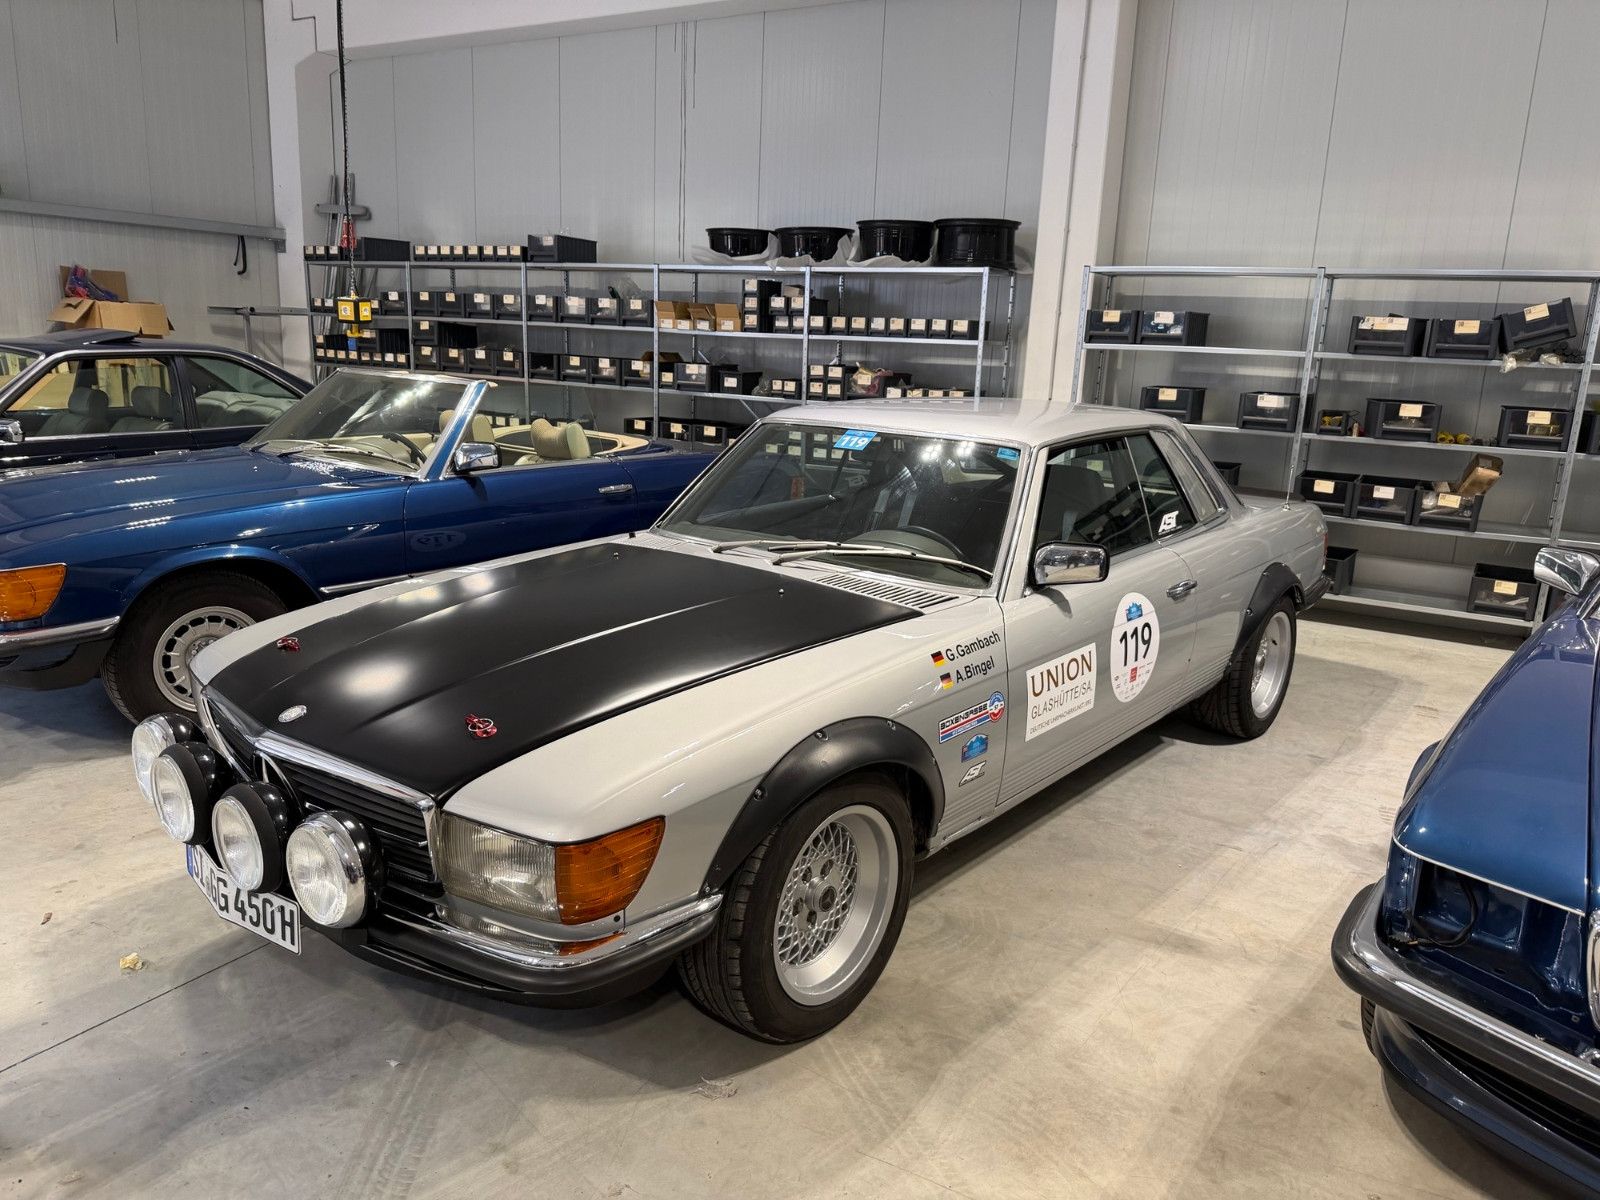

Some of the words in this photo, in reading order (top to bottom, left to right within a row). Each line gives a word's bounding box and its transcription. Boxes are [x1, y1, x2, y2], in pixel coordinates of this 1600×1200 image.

[841, 436, 869, 448] 119
[945, 631, 1001, 662] G.Gambach
[1119, 622, 1152, 667] 119
[956, 656, 995, 684] A.Bingel
[1030, 650, 1092, 698] UNION
